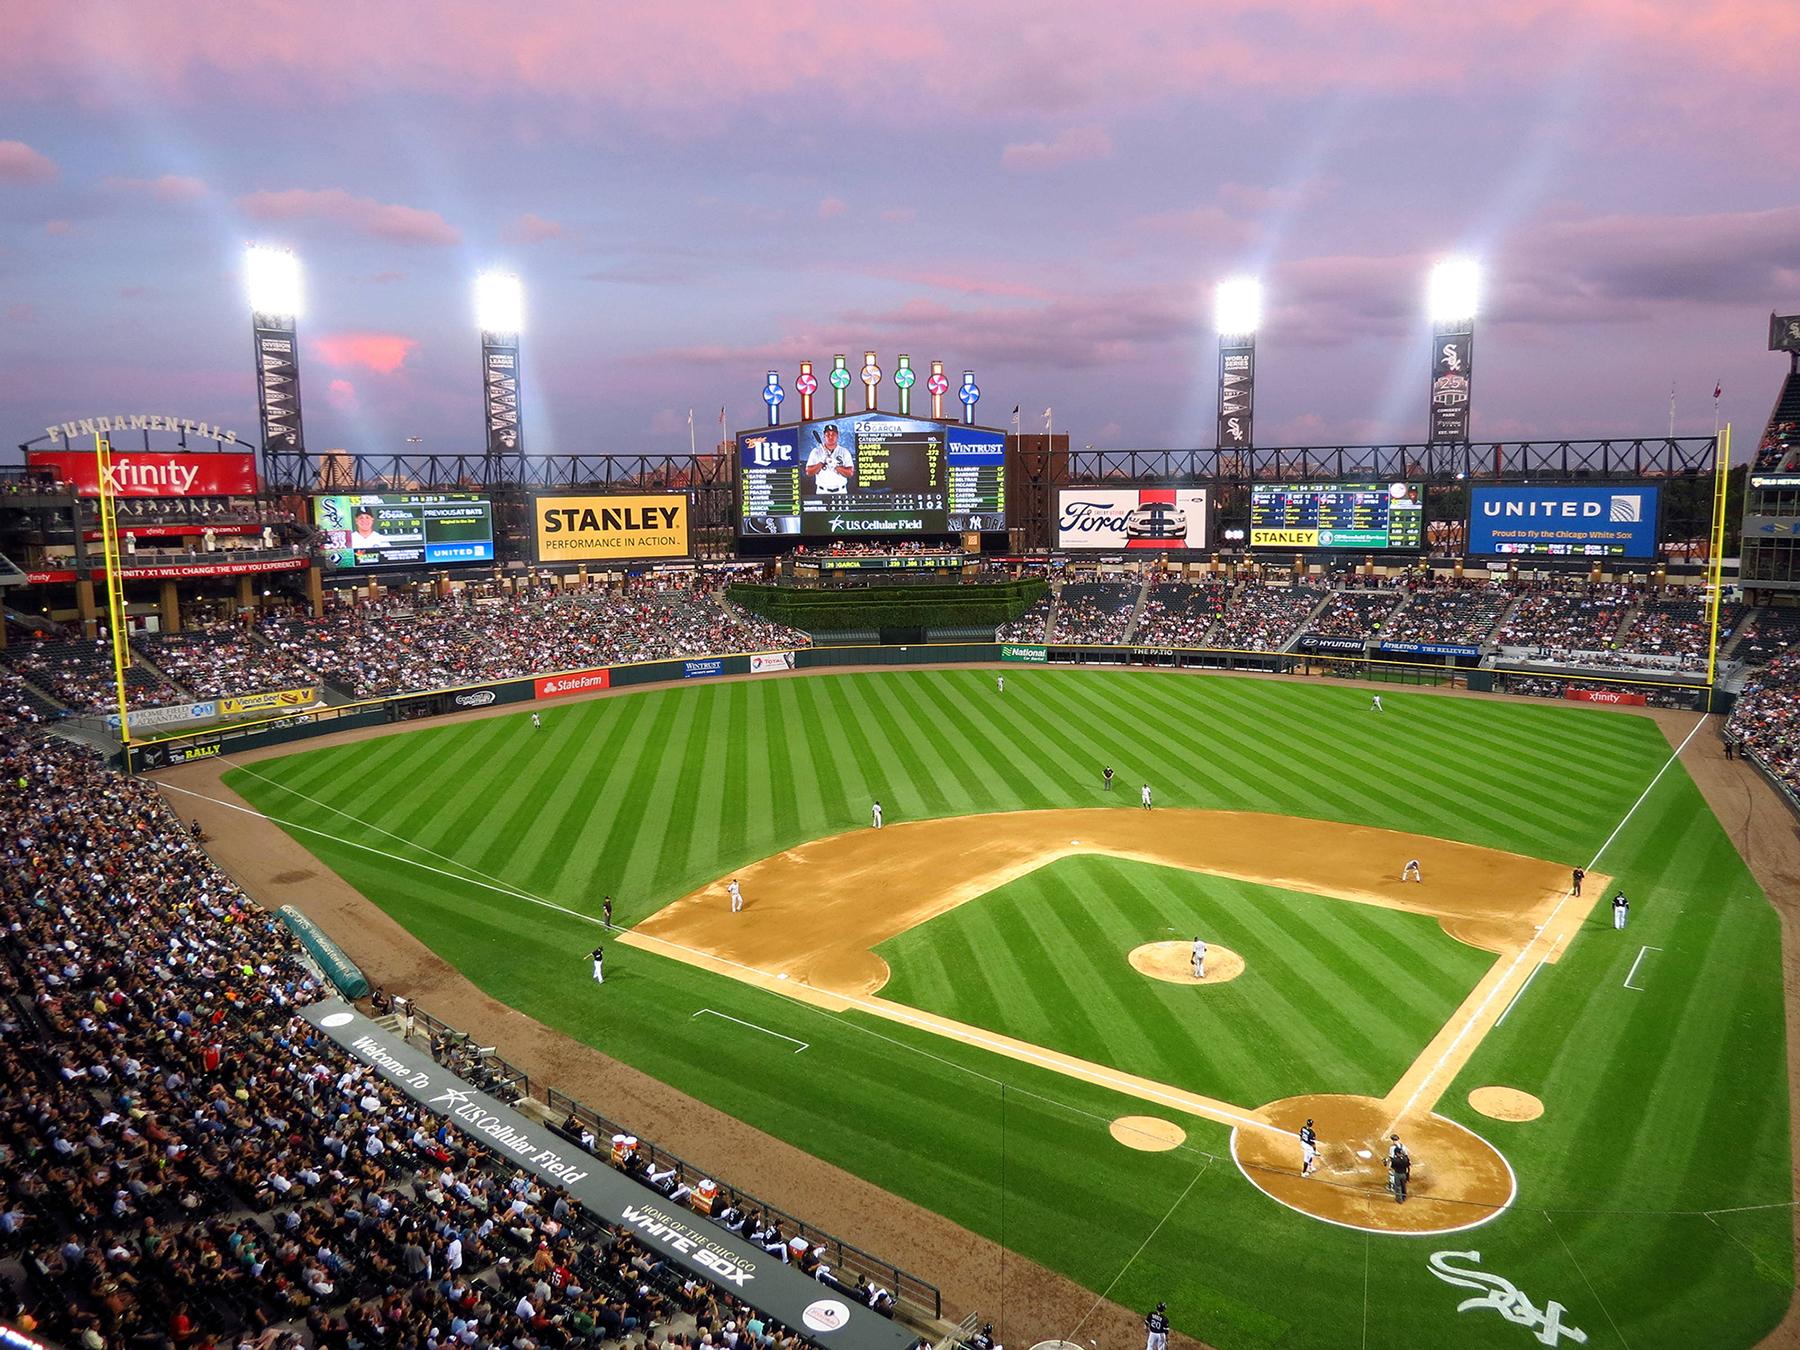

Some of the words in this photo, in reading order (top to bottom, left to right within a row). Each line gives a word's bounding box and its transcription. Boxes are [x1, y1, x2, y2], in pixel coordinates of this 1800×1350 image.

[1440, 378, 1460, 390] 25
[46, 415, 237, 445] FUNDAMENTALS
[855, 422, 872, 432] 26
[949, 442, 1003, 453] WINTRUST
[753, 441, 793, 466] Lite
[102, 458, 199, 496] xfinity
[935, 501, 943, 509] 2
[1484, 501, 1601, 517] UNITED
[379, 509, 391, 519] 26
[424, 509, 457, 517] PREVIOUS
[1059, 501, 1134, 532] Ford
[544, 506, 680, 533] STANLEY
[861, 519, 898, 530] Cellular
[898, 519, 922, 529] Field
[146, 527, 166, 535] xfinity
[1492, 530, 1517, 538] Proud
[1528, 530, 1539, 539] fly
[1540, 530, 1555, 538] the
[1555, 531, 1587, 540] Chicago
[1589, 531, 1614, 539] White
[1615, 531, 1632, 539] Sox
[1254, 532, 1314, 542] STANLEY
[545, 537, 621, 549] PERFORMANCE
[624, 537, 635, 546] IN
[433, 548, 473, 557] UNITED
[112, 569, 146, 578] XFINITY
[147, 568, 158, 577] X1
[160, 567, 181, 576] WILL
[182, 566, 215, 575] CHANGE
[216, 564, 230, 573] THE
[231, 563, 249, 572] WAY
[249, 562, 262, 571] YOU
[262, 560, 295, 571] EXPERIENCE
[1319, 640, 1362, 649] HYUNDAI
[1382, 641, 1419, 650] ATHLETICO
[1011, 647, 1046, 657] National
[1149, 648, 1173, 656] PATIO
[1437, 647, 1476, 656] RELIEVERS
[685, 661, 721, 669] WINTRUST
[236, 696, 262, 705] Vienna
[1589, 692, 1620, 704] xfinity
[136, 709, 163, 719] HOME
[166, 706, 189, 715] FIELD
[138, 713, 189, 726] ADVANTAGE
[185, 744, 221, 759] RALLY
[352, 1035, 409, 1077] Welcome
[406, 1073, 432, 1089] To
[476, 1115, 537, 1163] Cellular
[529, 1148, 589, 1186] Field
[640, 1204, 673, 1224] HOME
[670, 1220, 688, 1233] OF
[685, 1229, 709, 1246] THE
[706, 1242, 756, 1272] CHICAGO
[621, 1205, 698, 1254] WHITE
[691, 1248, 756, 1288] SOX
[1427, 1250, 1588, 1347] Sox
[1150, 1319, 1161, 1330] 20
